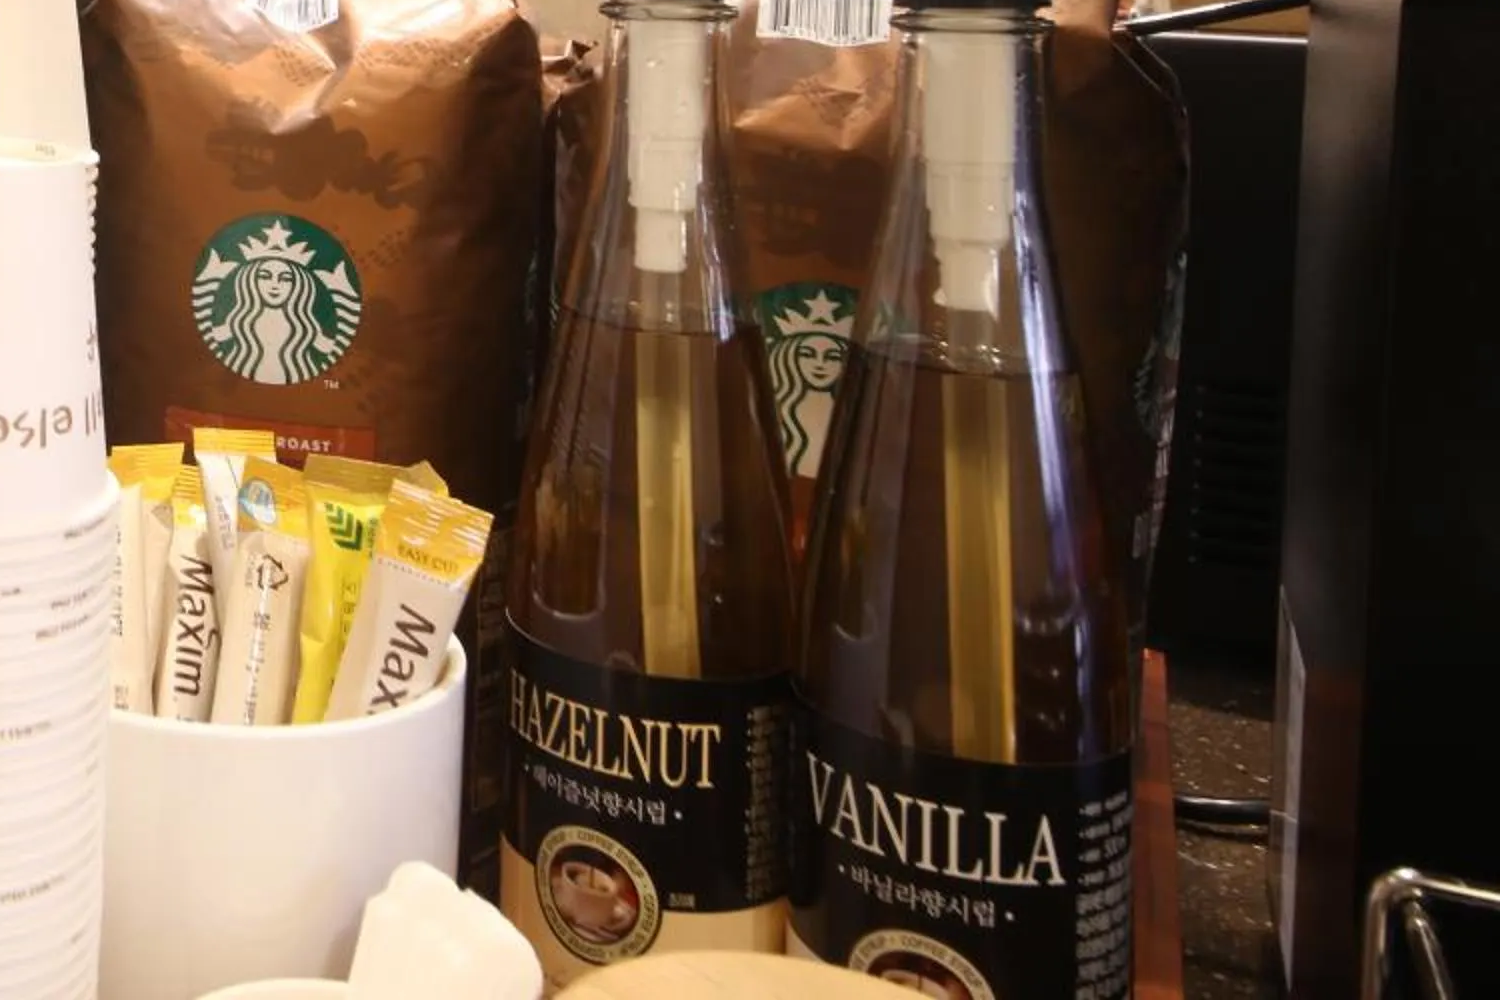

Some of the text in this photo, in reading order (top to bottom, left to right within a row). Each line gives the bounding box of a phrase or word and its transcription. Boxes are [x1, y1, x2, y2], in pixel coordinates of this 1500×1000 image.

[276, 435, 331, 453] ROAST
[176, 554, 222, 698] Maxim
[510, 666, 722, 789] HAZELNUT
[805, 751, 1067, 888] VANILLA
[850, 864, 997, 929] 바닐라향시럽
